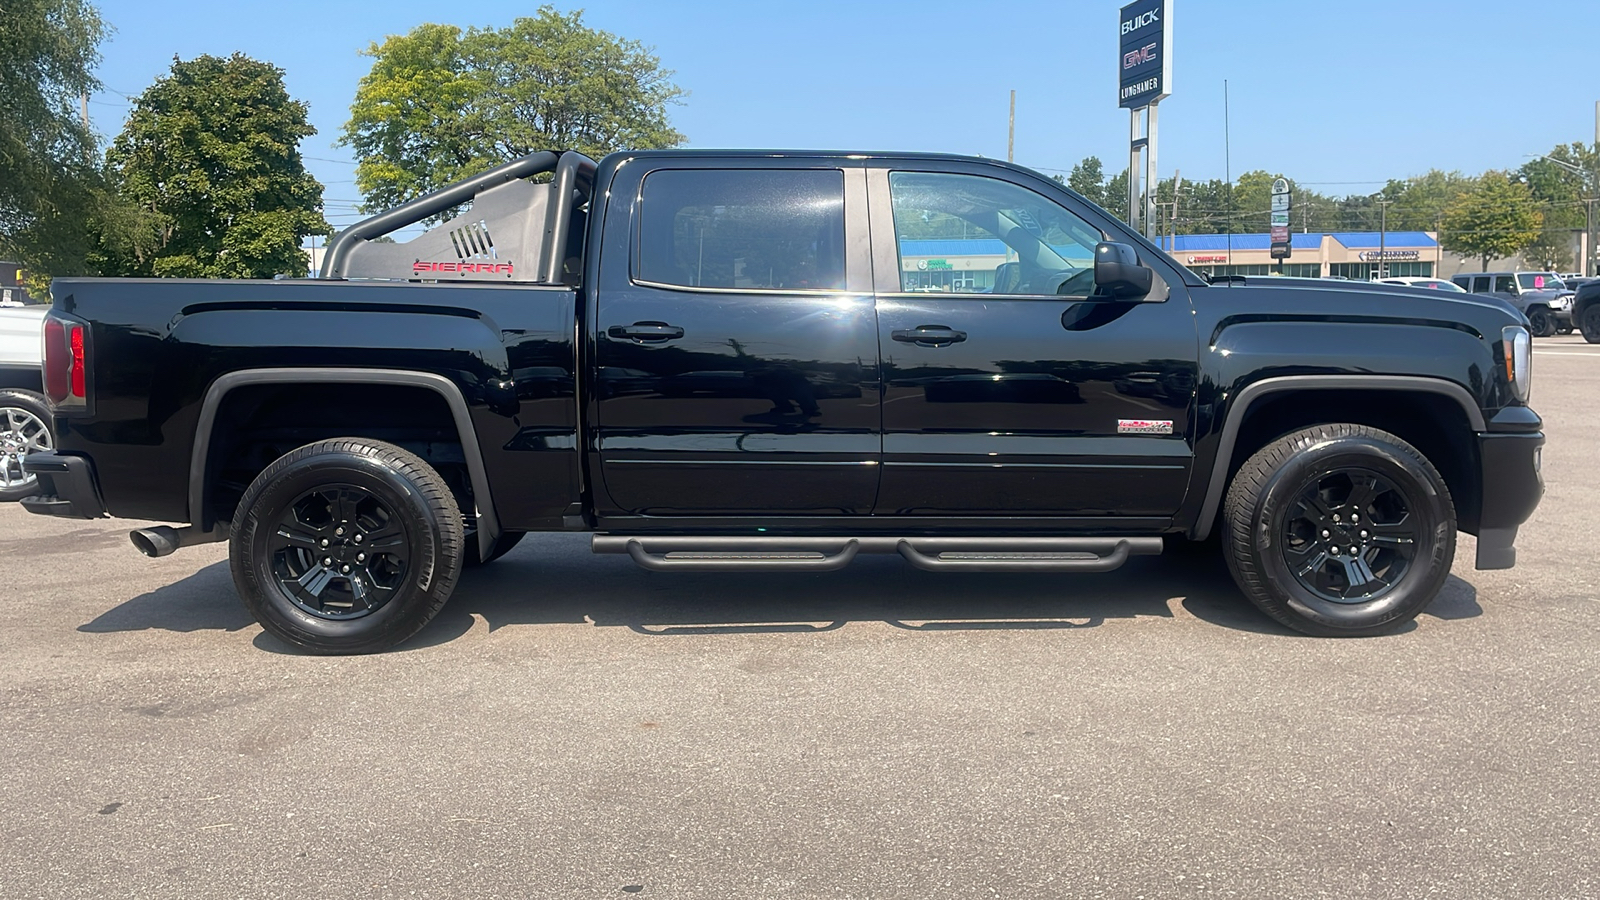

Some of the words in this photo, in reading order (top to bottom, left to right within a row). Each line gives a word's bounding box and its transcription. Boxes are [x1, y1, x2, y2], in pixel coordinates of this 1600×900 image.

[1121, 7, 1159, 35] BUICK
[1123, 42, 1157, 70] GMC
[1121, 77, 1158, 99] LUNGHAMER
[412, 261, 514, 274] SIERRA
